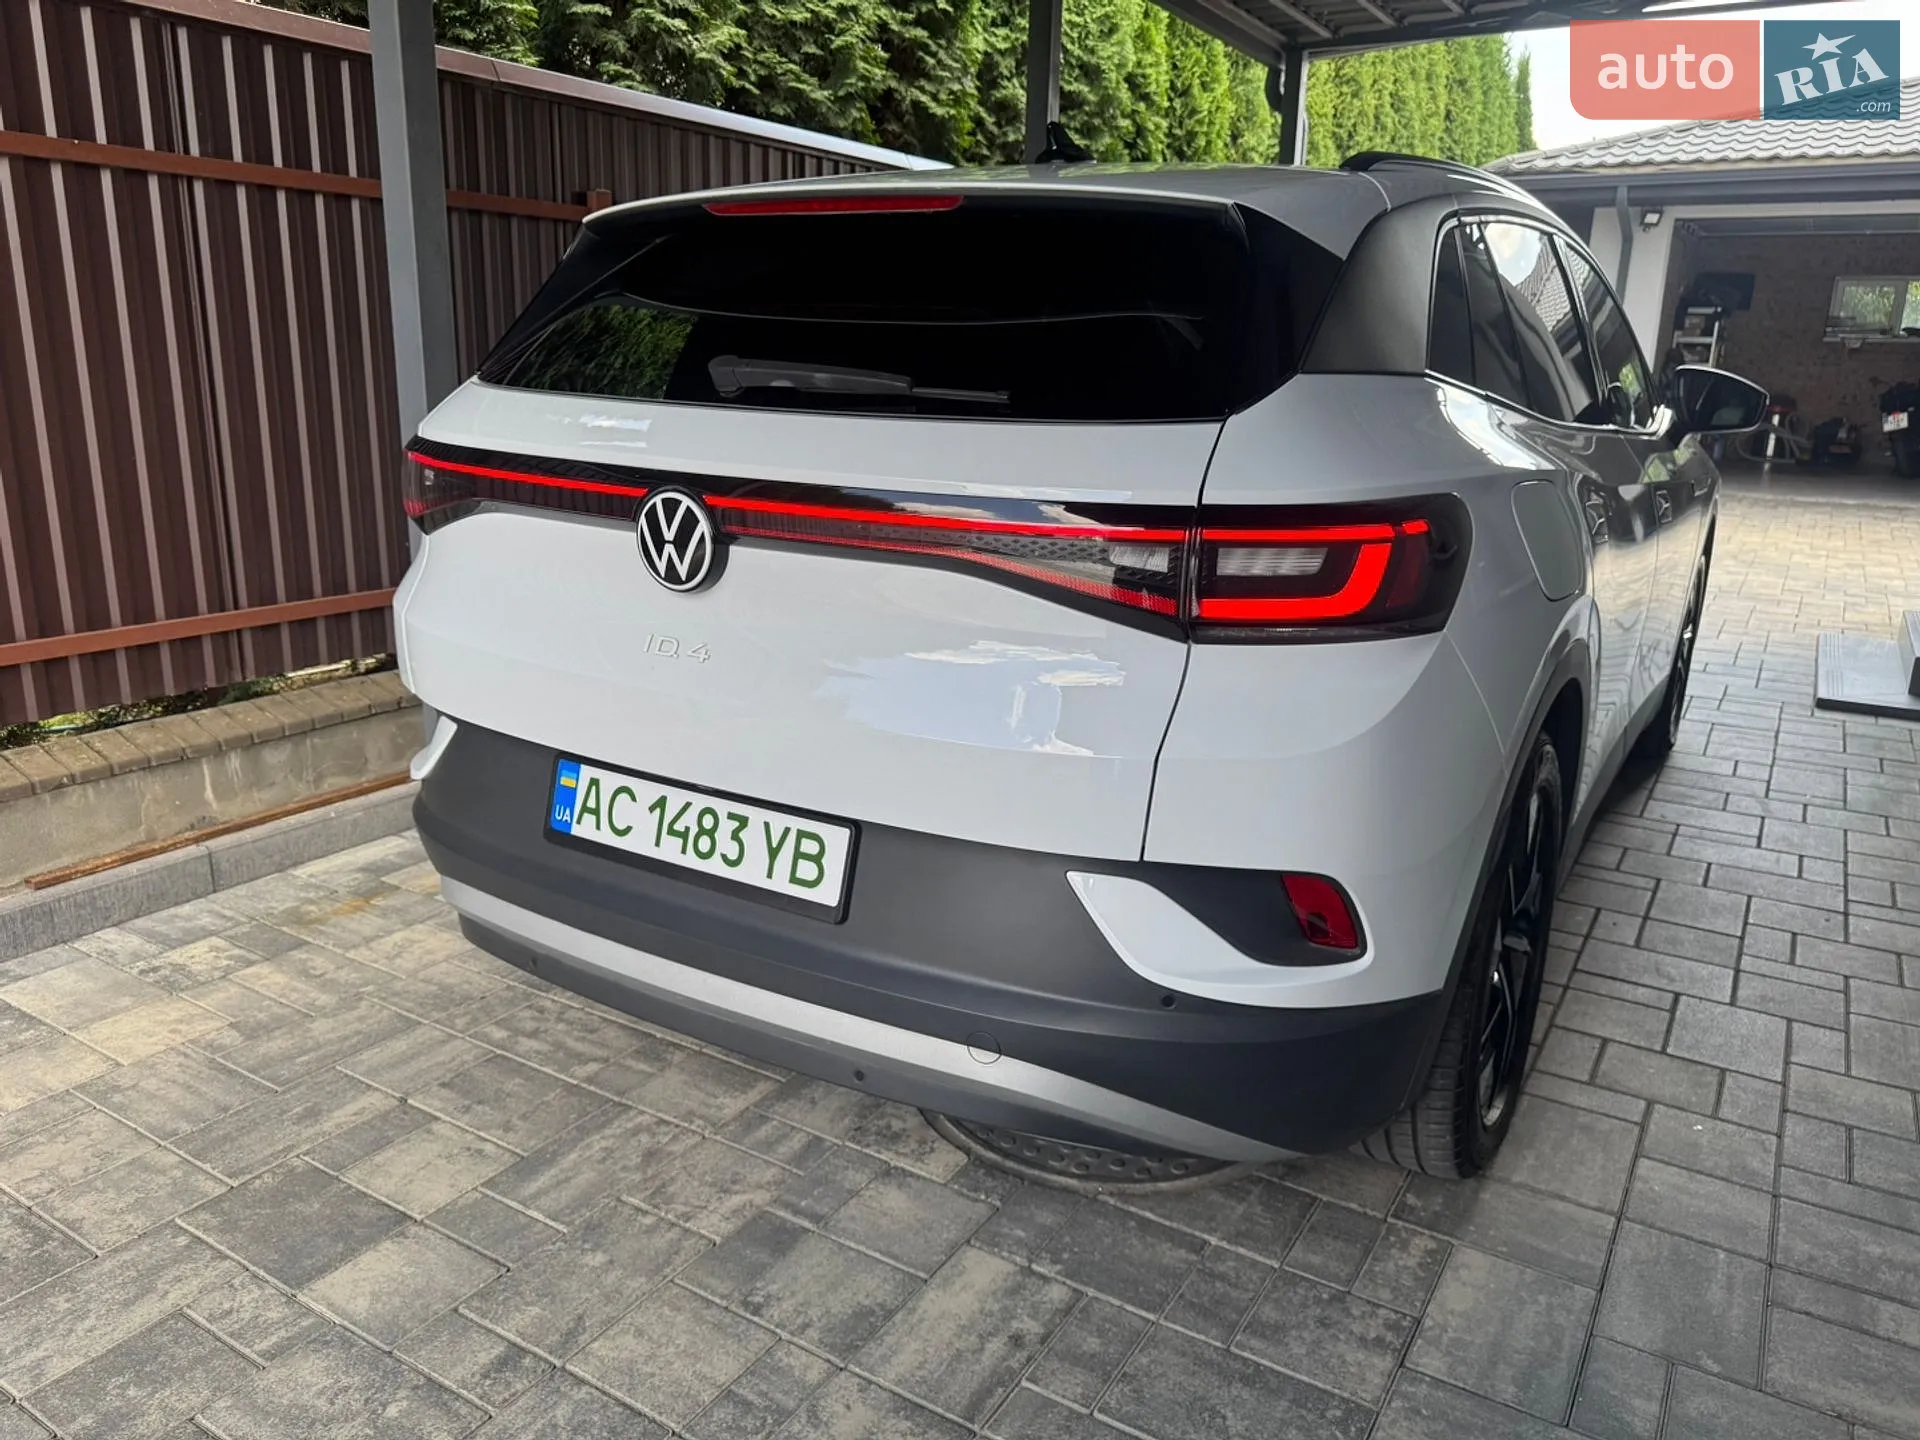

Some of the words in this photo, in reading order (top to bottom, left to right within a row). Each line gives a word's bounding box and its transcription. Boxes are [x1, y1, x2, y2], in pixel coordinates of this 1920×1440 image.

[554, 804, 571, 823] UA
[576, 777, 637, 837] AC
[648, 795, 750, 868] 1483
[763, 820, 827, 889] YB
